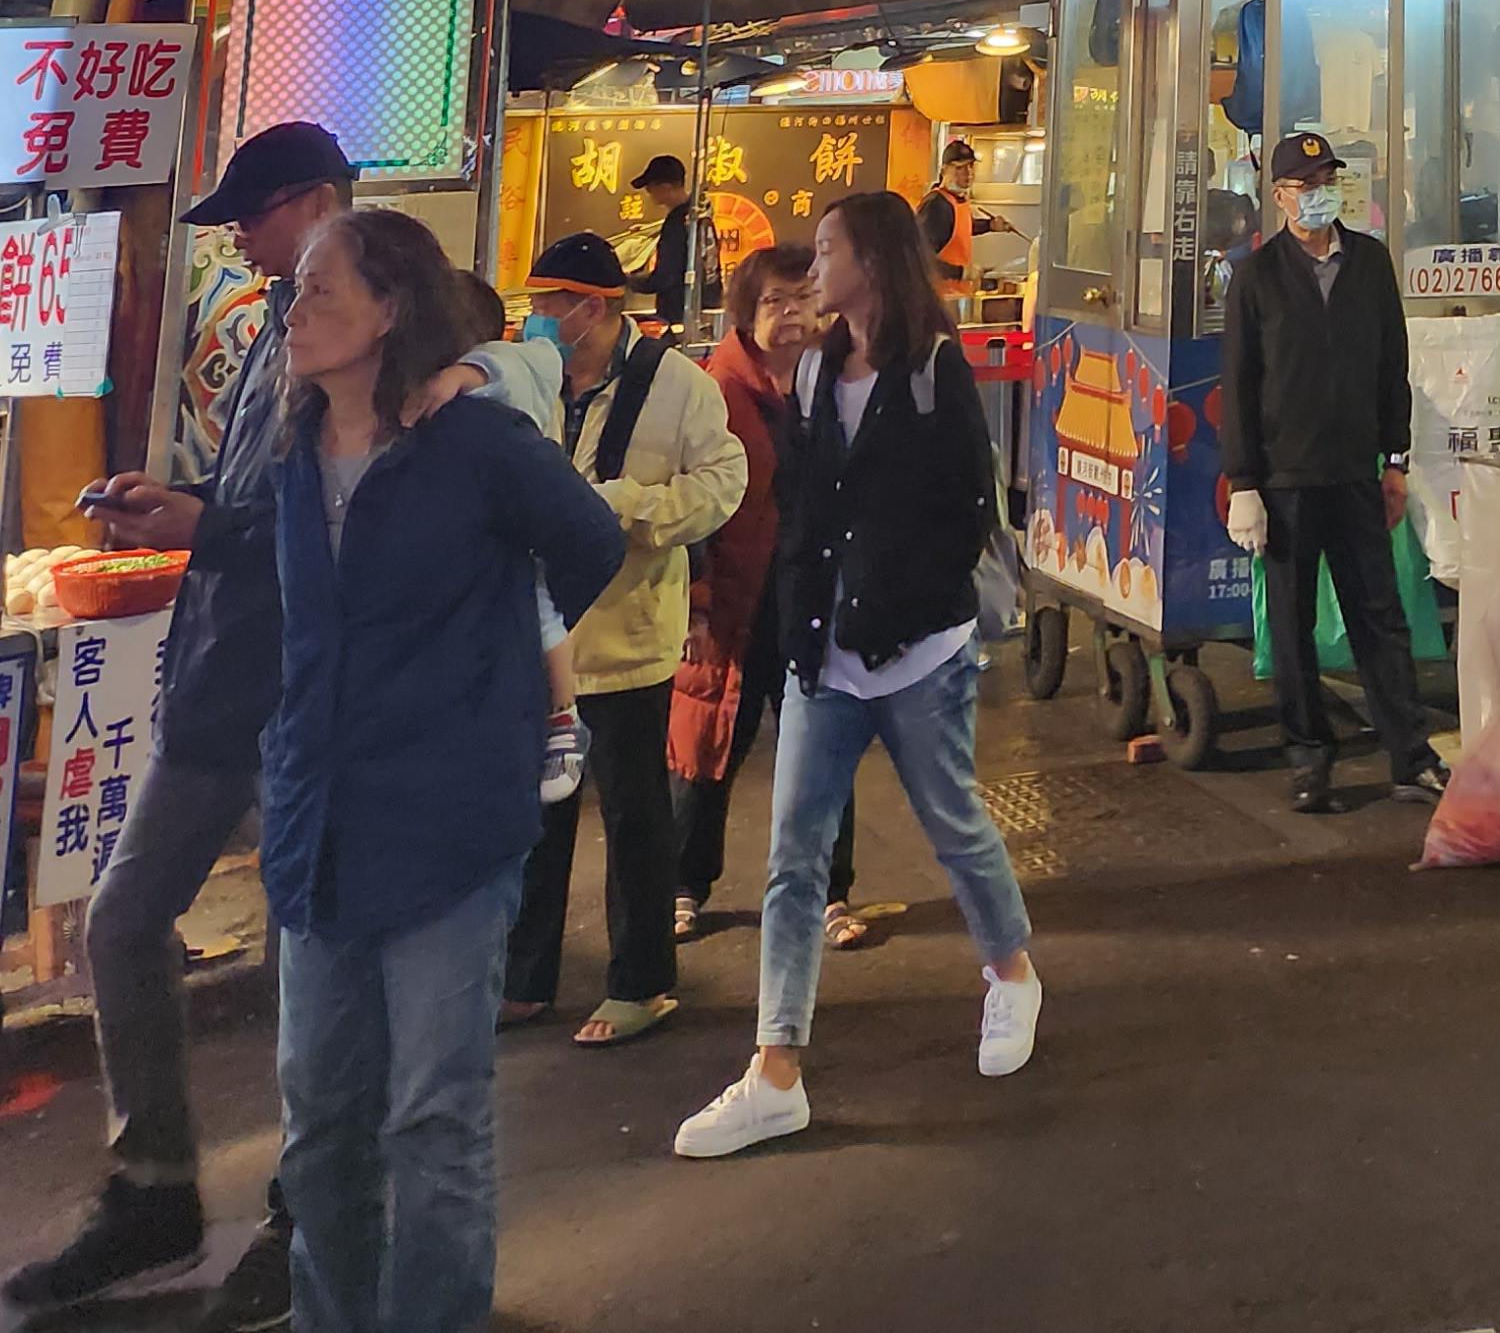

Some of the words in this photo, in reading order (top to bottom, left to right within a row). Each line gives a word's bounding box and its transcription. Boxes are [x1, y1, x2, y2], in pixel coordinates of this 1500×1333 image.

[16, 39, 181, 101] 不好吃
[16, 109, 151, 175] 免費
[1174, 151, 1198, 261] 請靠右走
[55, 637, 106, 857] 客人虐我
